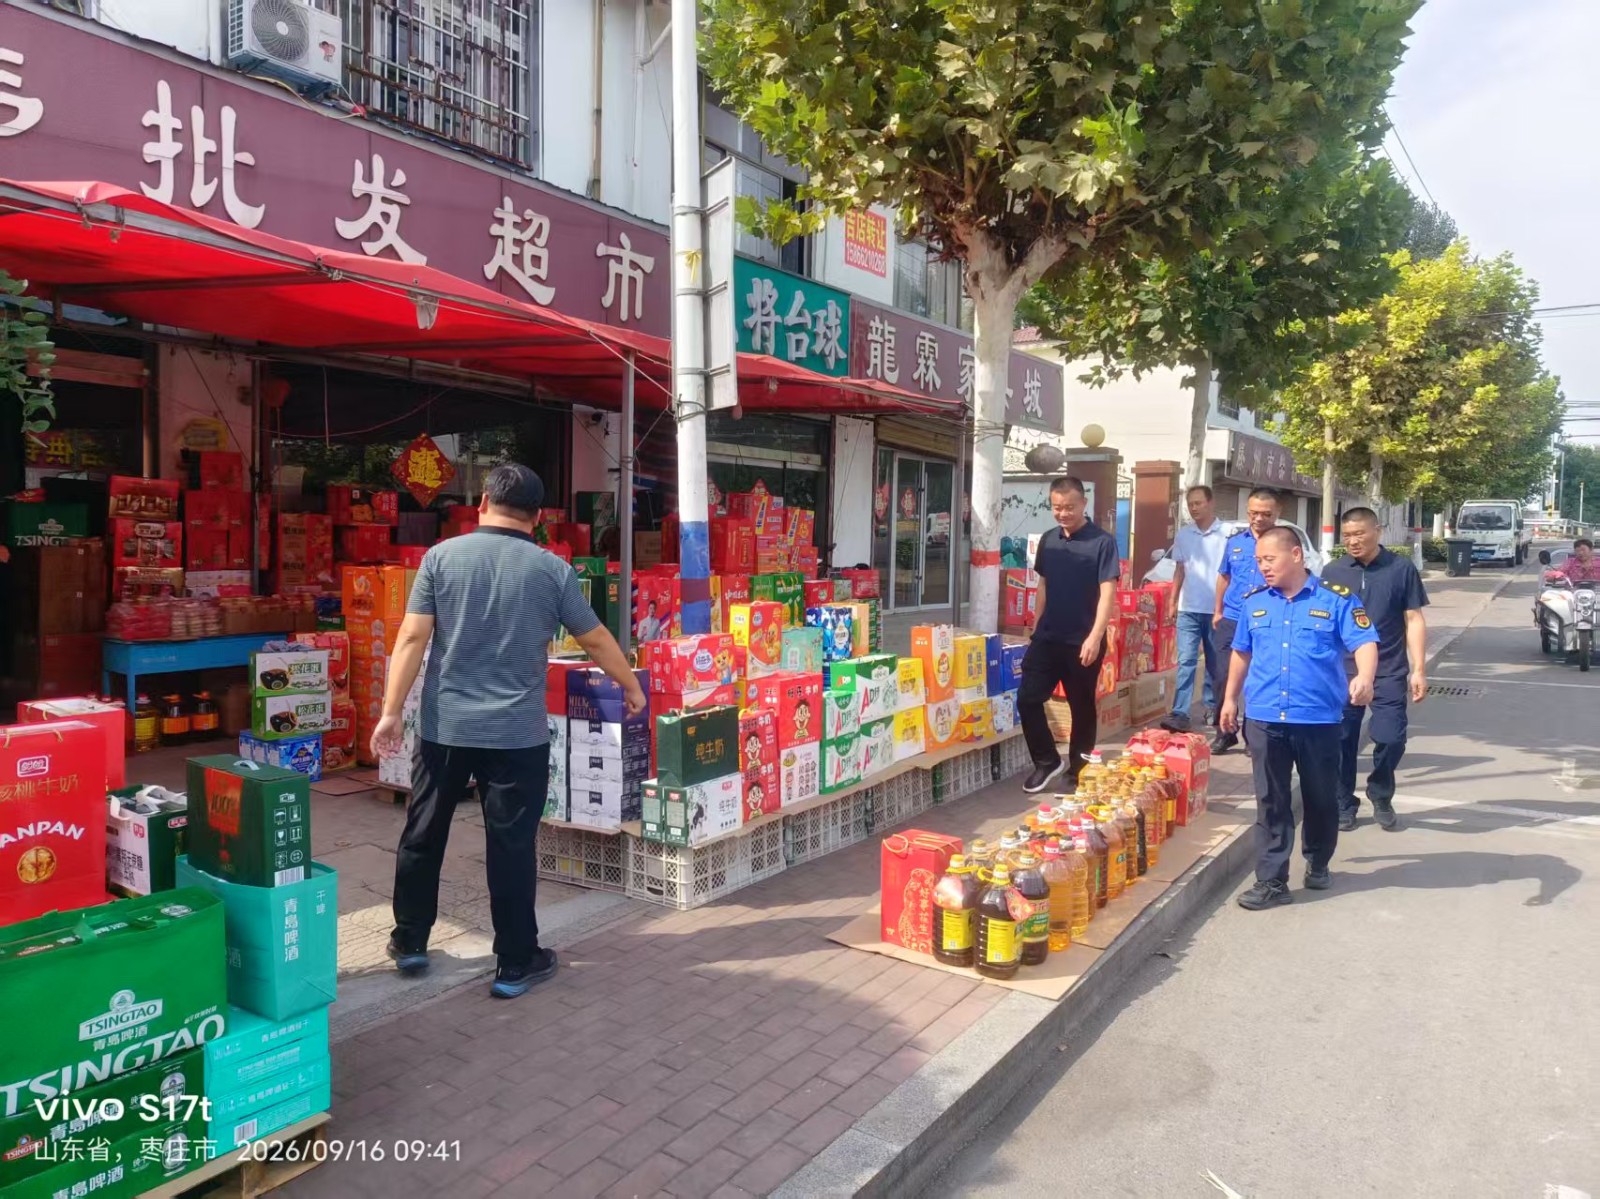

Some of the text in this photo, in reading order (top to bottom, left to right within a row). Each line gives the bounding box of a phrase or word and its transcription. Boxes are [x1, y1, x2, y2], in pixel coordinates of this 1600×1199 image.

[866, 313, 1043, 418] 龍霖家城
[0, 1013, 225, 1117] TSINGTAO
[85, 1004, 157, 1034] TSINGTAO
